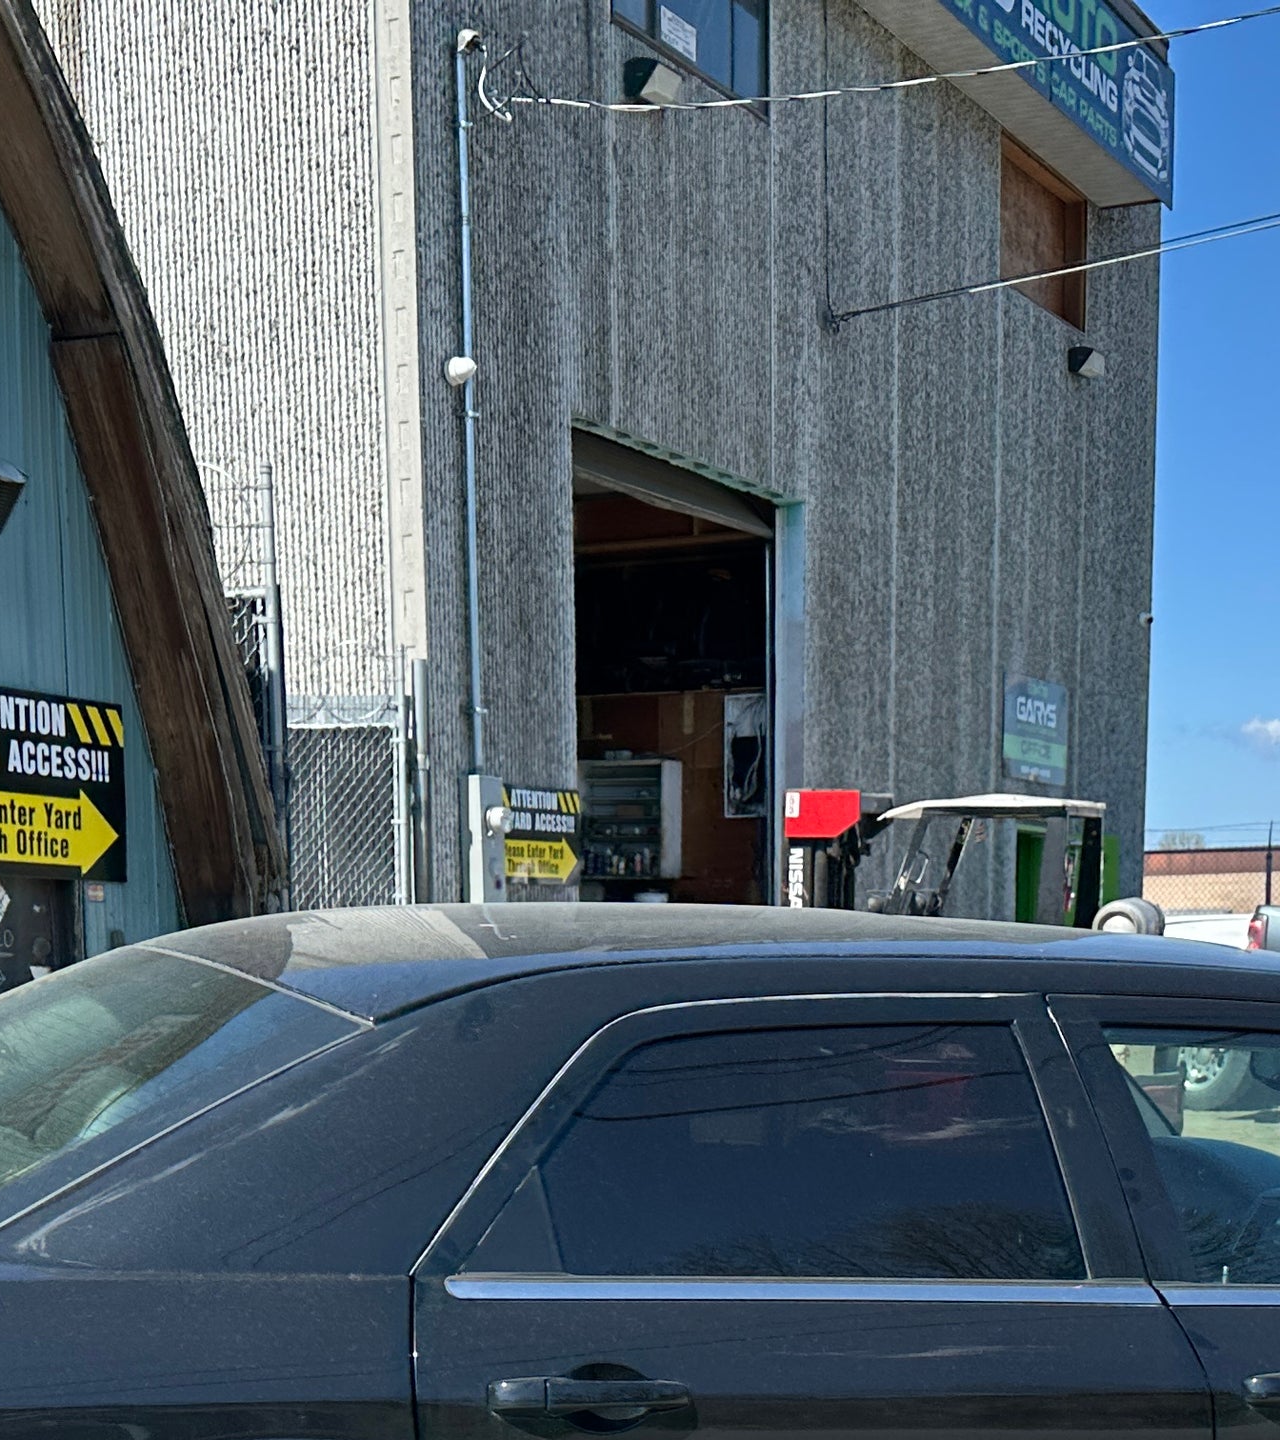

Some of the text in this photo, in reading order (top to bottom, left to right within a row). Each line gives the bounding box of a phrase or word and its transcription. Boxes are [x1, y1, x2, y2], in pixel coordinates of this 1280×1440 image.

[1021, 2, 1118, 113] RECYCLING
[1051, 71, 1076, 112] CAR
[1079, 99, 1117, 148] PARTS
[7, 738, 110, 783] ACCESS!!!
[43, 802, 82, 831] Yard
[510, 788, 559, 811] ATTENTION
[15, 828, 70, 858] Office
